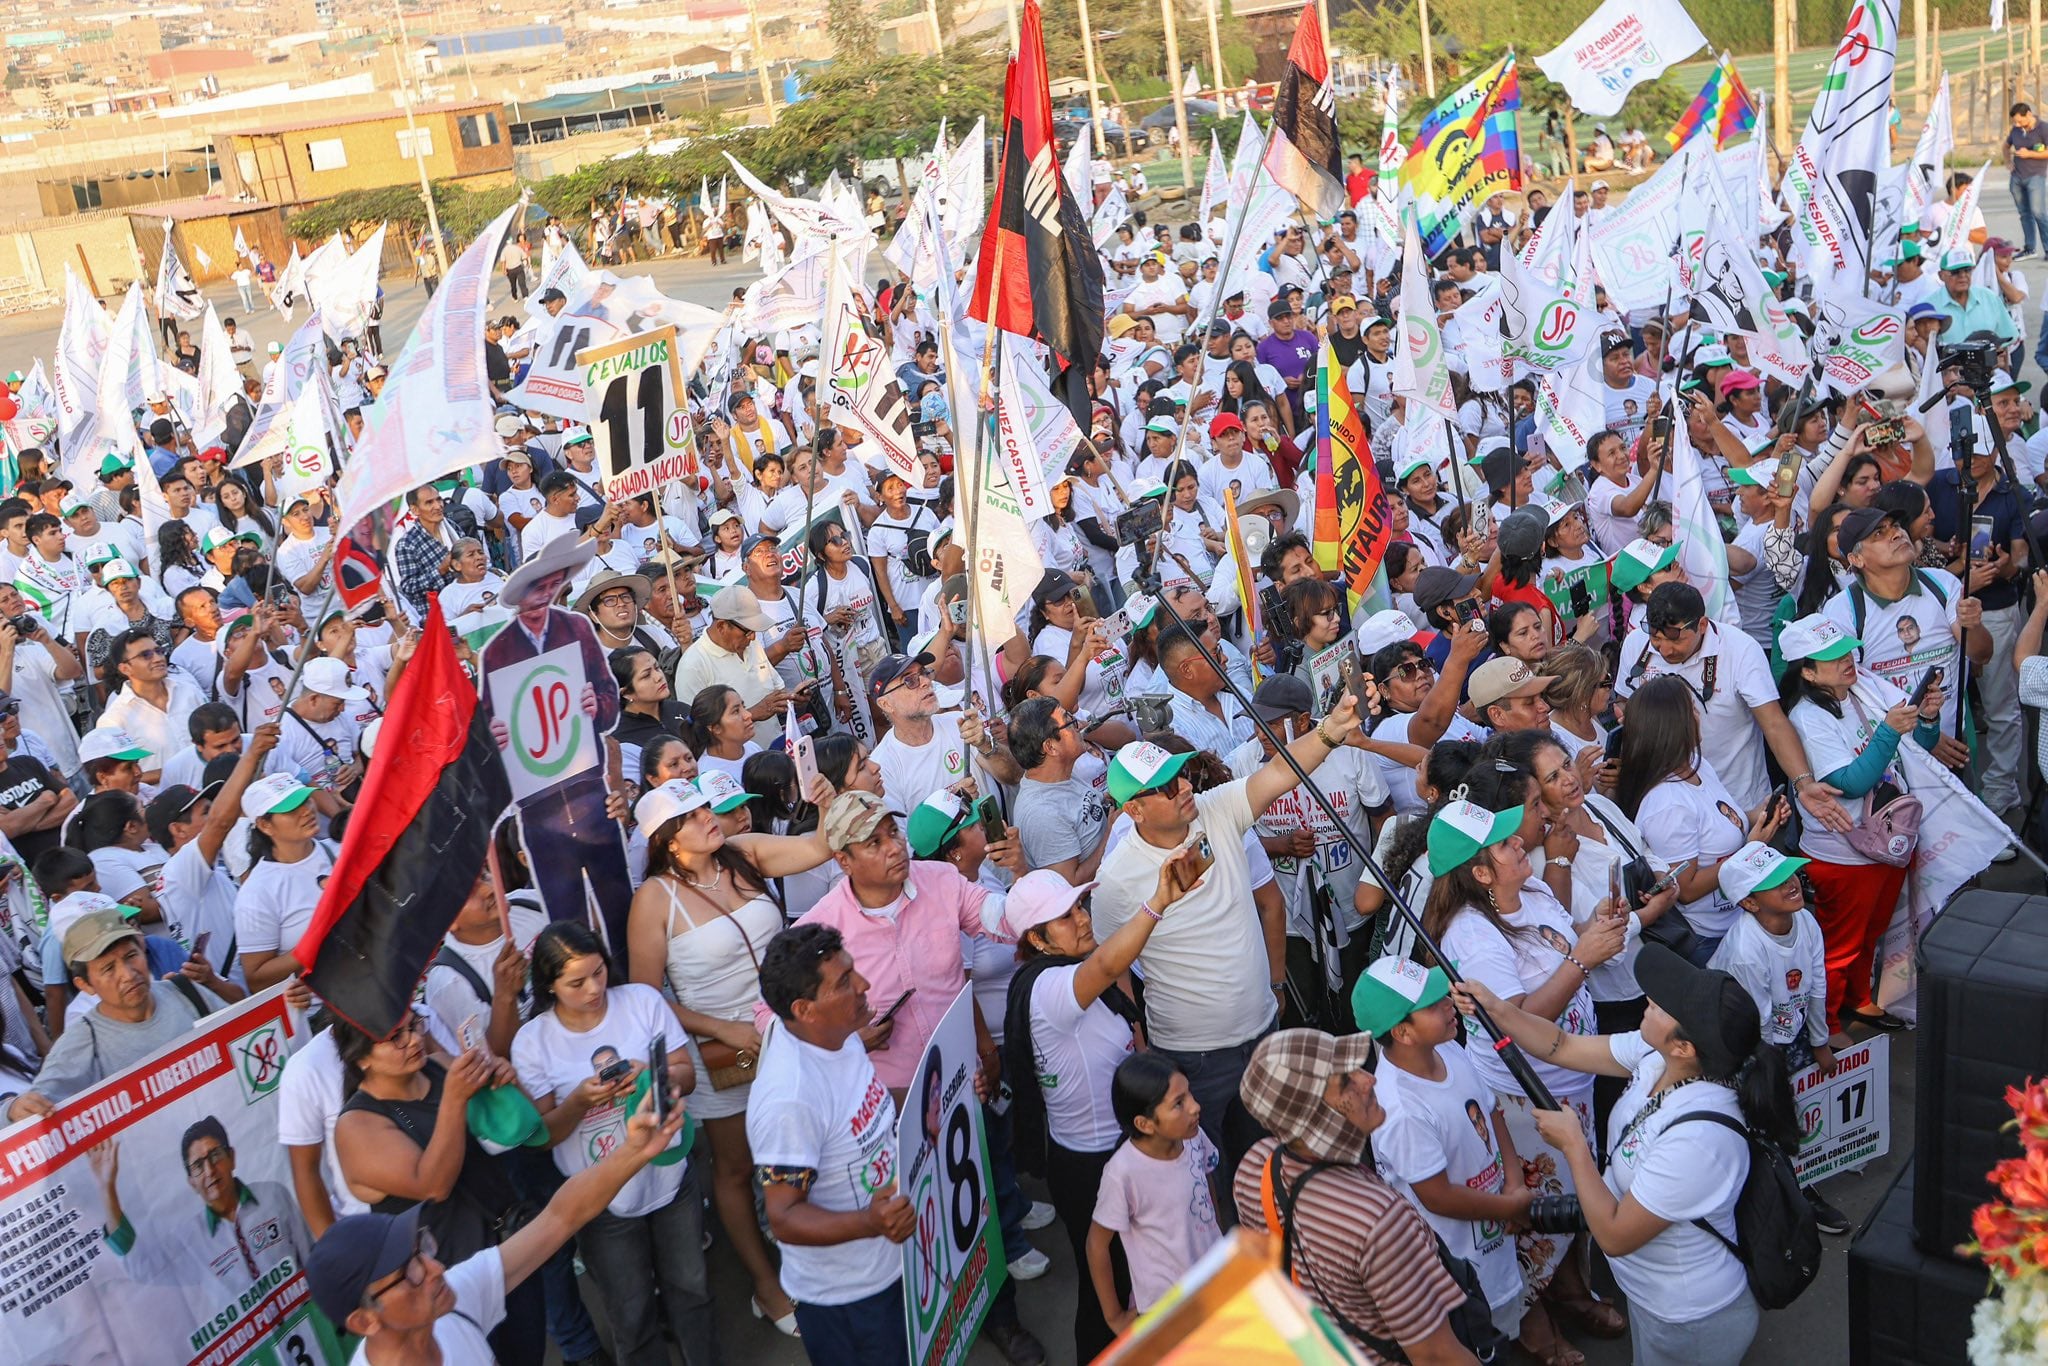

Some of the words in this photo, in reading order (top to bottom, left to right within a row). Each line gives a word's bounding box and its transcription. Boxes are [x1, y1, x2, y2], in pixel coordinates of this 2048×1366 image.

[1796, 143, 1818, 181] CHEZ
[1542, 306, 1576, 341] JP
[587, 341, 668, 387] CEVALLOS
[54, 365, 73, 414] CASTILLO
[600, 364, 664, 476] 11
[671, 415, 690, 441] JP
[1329, 418, 1355, 444] UNIDO
[607, 469, 649, 503] SENADO
[1006, 439, 1035, 507] CASTILLO
[1551, 567, 1591, 594] JANET
[1875, 657, 1907, 670] CLEDIN
[1912, 646, 1950, 661] VASQUEZ
[529, 682, 570, 760] JP
[1329, 791, 1348, 808] VA!
[1330, 841, 1349, 867] 19
[1764, 850, 1774, 859] 2
[942, 1062, 967, 1114] ESCRIBE
[1797, 1077, 1805, 1094] A
[1836, 1080, 1867, 1124] 17
[6, 1128, 66, 1177] PEDRO
[946, 1102, 980, 1252] 8
[1470, 1164, 1496, 1188] CLEDIN
[25, 1197, 44, 1213] DE
[44, 1184, 66, 1202] LOS
[53, 1203, 62, 1214] Y
[267, 1223, 279, 1240] 3
[53, 1254, 61, 1264] Y
[3, 1299, 18, 1313] EN
[20, 1288, 35, 1303] LA
[37, 1256, 87, 1292] CAMARA
[86, 1245, 101, 1260] DE
[953, 1236, 989, 1319] PALACIOS
[190, 1304, 239, 1351] HILSO
[239, 1259, 293, 1312] RAMOS
[252, 1301, 281, 1332] POR
[959, 1277, 990, 1338] Nacional
